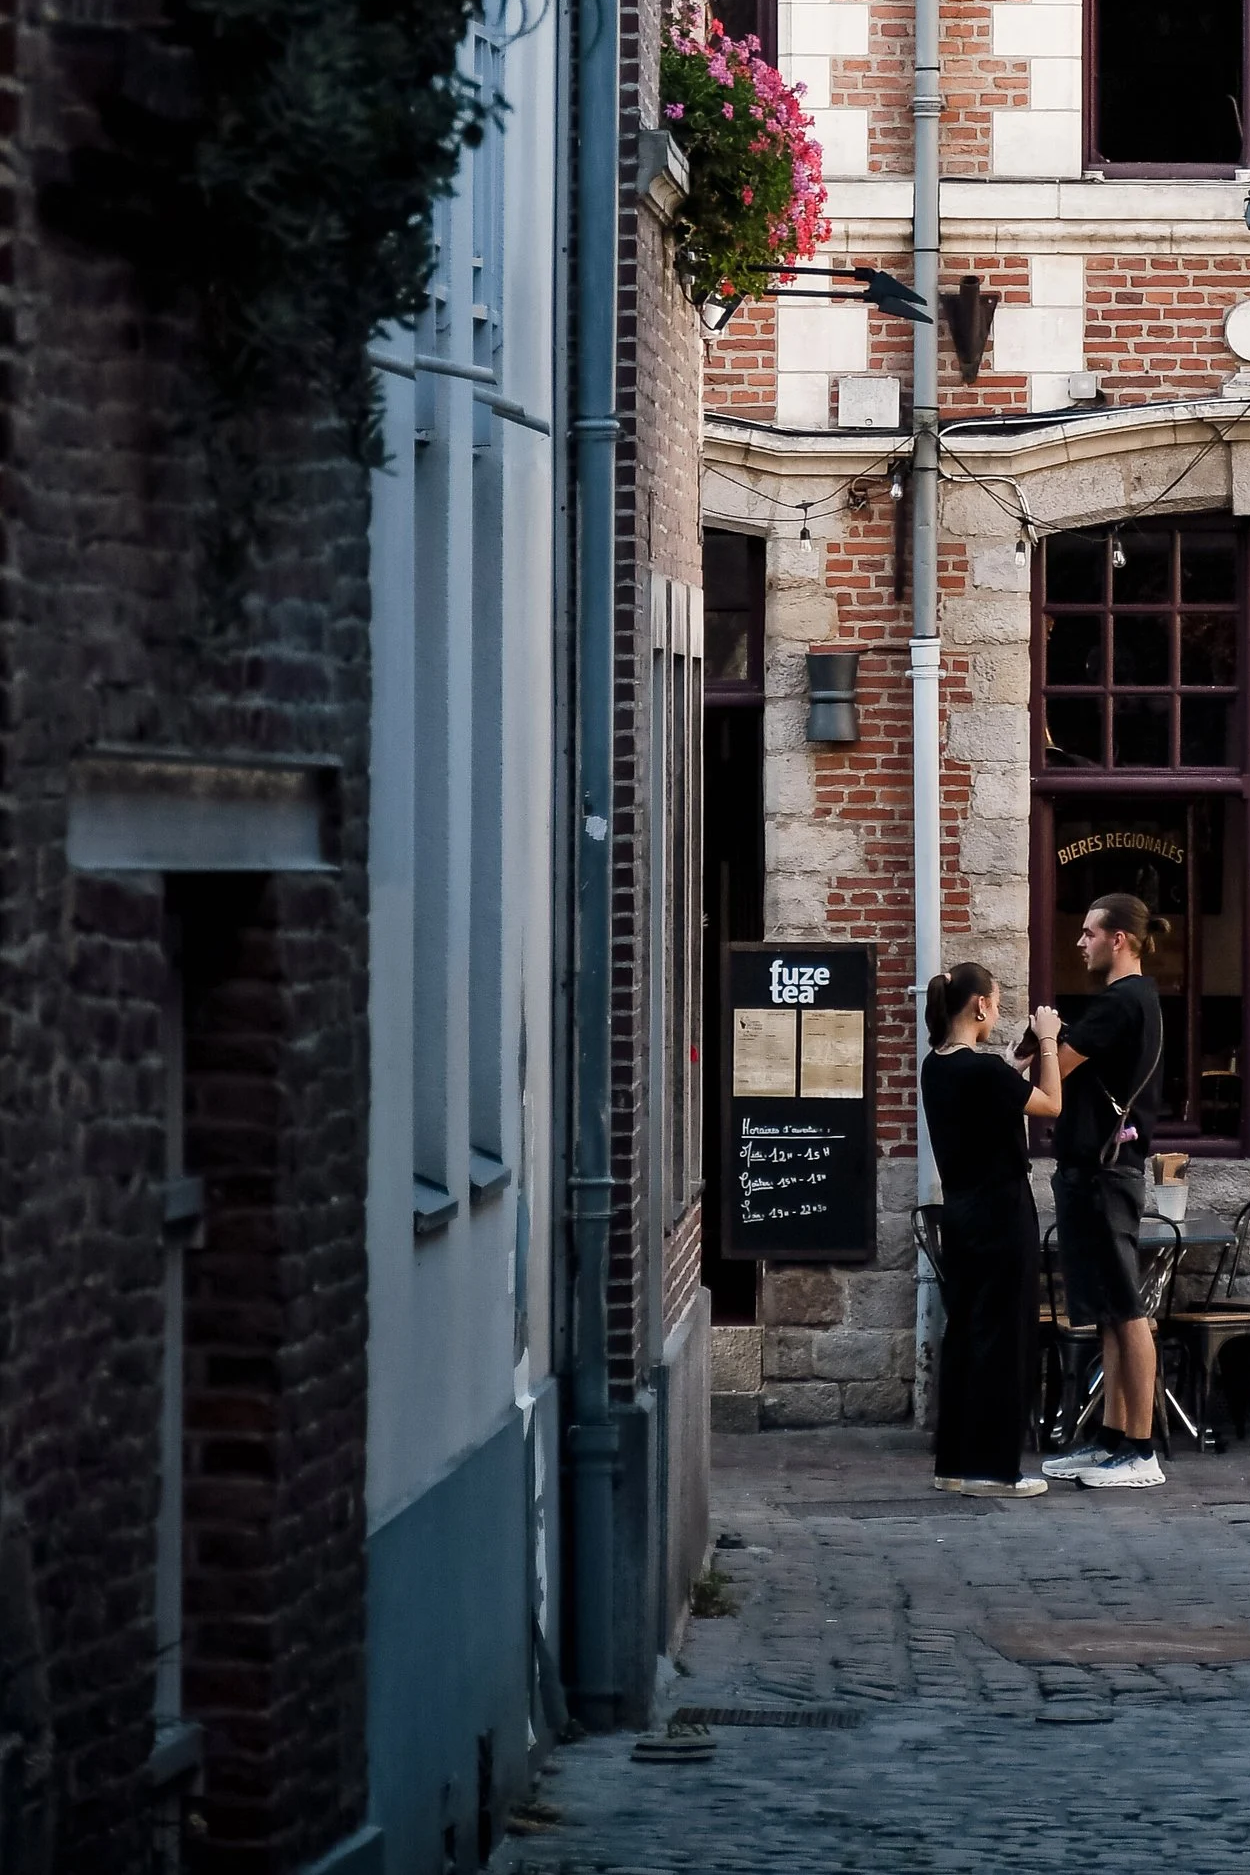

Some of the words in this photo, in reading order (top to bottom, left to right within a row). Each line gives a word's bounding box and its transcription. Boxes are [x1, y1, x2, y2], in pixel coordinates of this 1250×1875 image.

[1057, 835, 1102, 865] BIERES
[1105, 832, 1185, 864] REGIONALES
[768, 959, 830, 986] fuze
[768, 983, 816, 1004] tea
[742, 1117, 780, 1135] Horaires
[768, 1147, 793, 1163] 12H
